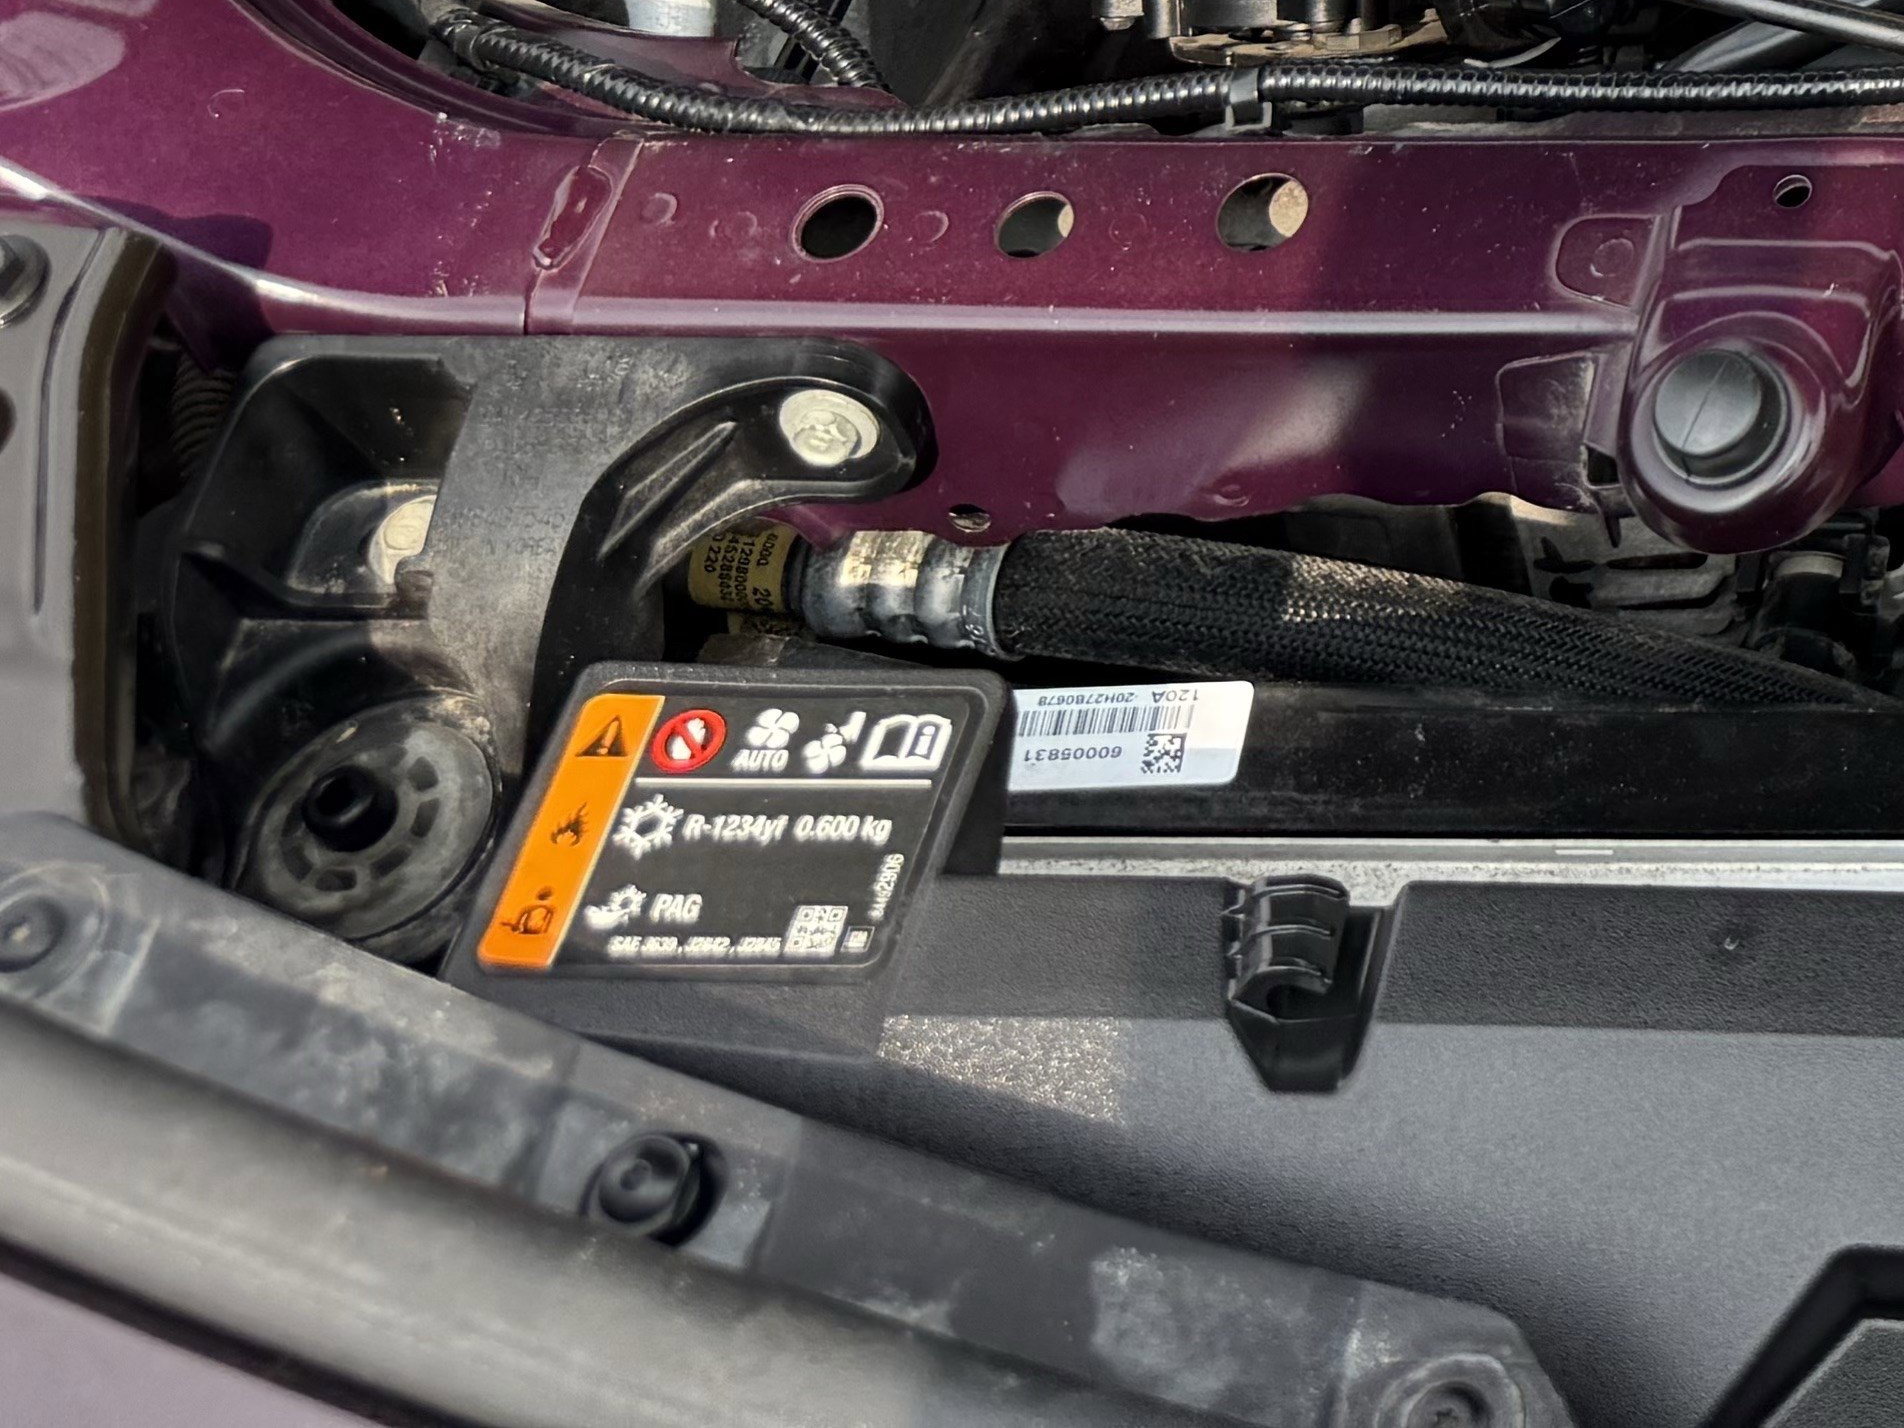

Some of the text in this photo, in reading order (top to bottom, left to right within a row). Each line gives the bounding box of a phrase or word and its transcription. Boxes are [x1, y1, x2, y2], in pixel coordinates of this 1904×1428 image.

[704, 545, 721, 574] 220
[1152, 689, 1199, 704] 120A
[732, 749, 790, 772] AUTO
[1024, 745, 1123, 763] 60005831
[682, 814, 892, 848] R-1234yf 0.600 kg
[650, 895, 704, 924] PAG
[608, 935, 642, 956] SAE
